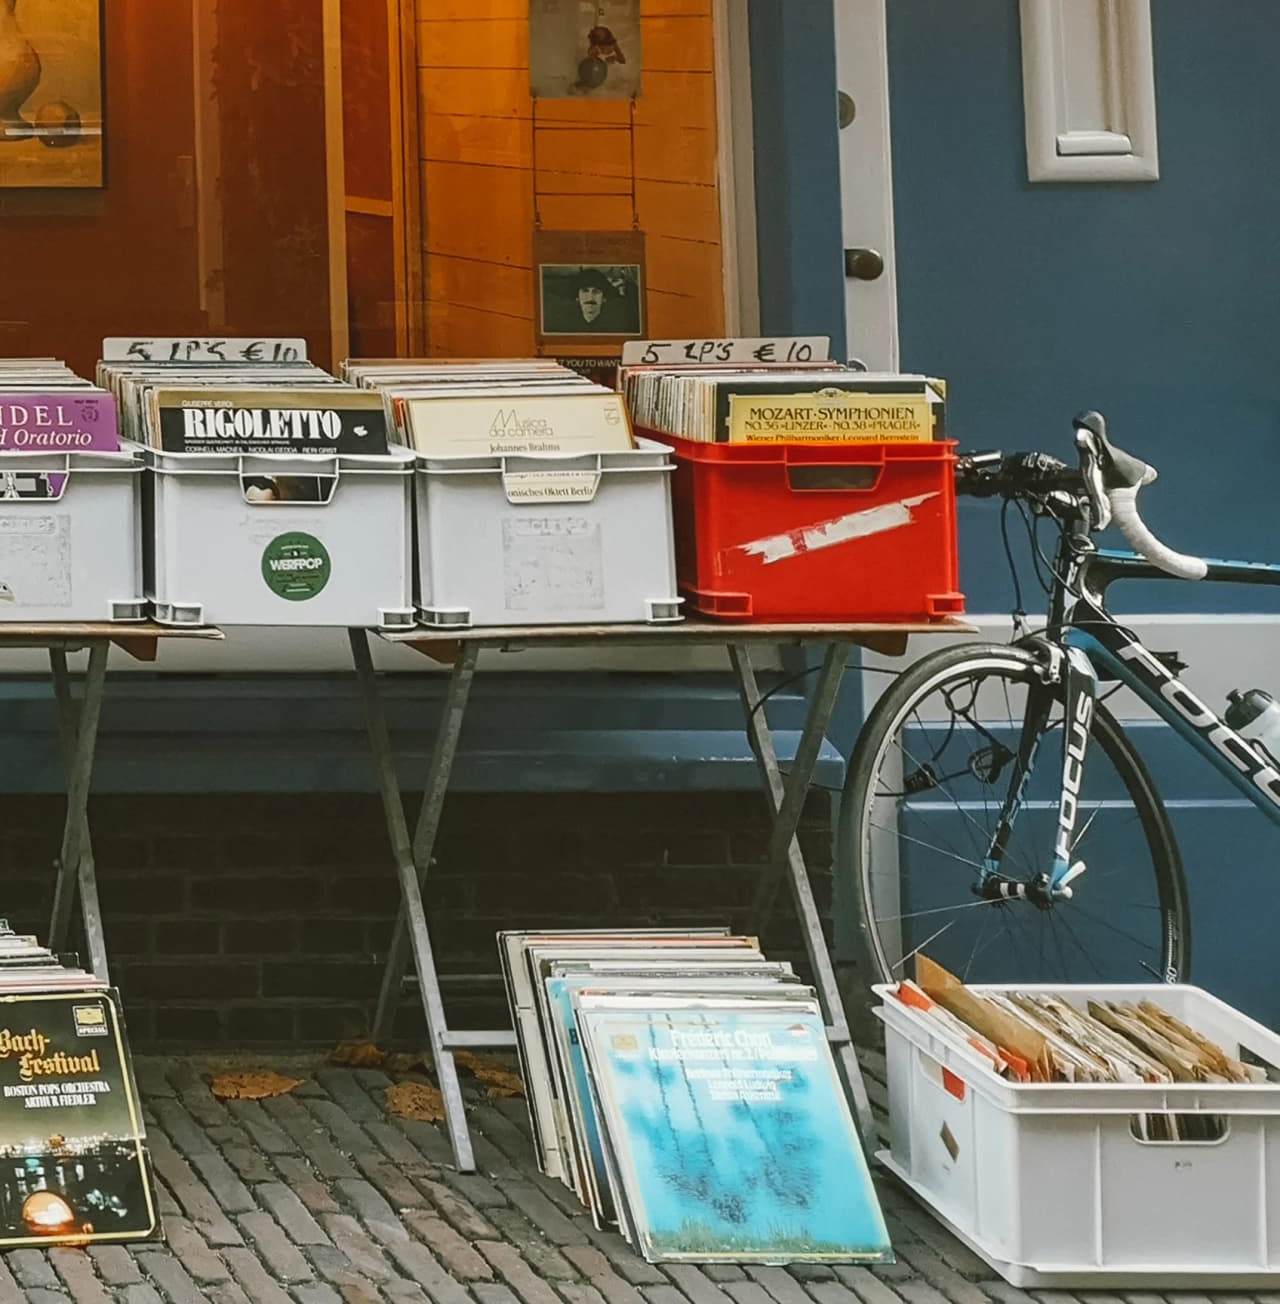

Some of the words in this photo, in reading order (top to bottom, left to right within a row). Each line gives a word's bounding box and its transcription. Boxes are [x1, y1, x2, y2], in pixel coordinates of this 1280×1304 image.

[641, 343, 672, 364] 5
[182, 408, 342, 440] RIGOLETTO
[13, 429, 93, 446] Oratorio
[490, 443, 528, 454] Johannes
[529, 442, 561, 452] Brahms
[1055, 691, 1093, 861] FOCUS
[18, 1048, 101, 1082] Festival
[3, 1084, 38, 1098] BOSTON
[38, 1083, 61, 1096] POPS
[60, 1080, 111, 1095] ORCHESTRA
[59, 1093, 97, 1107] FIEDLER
